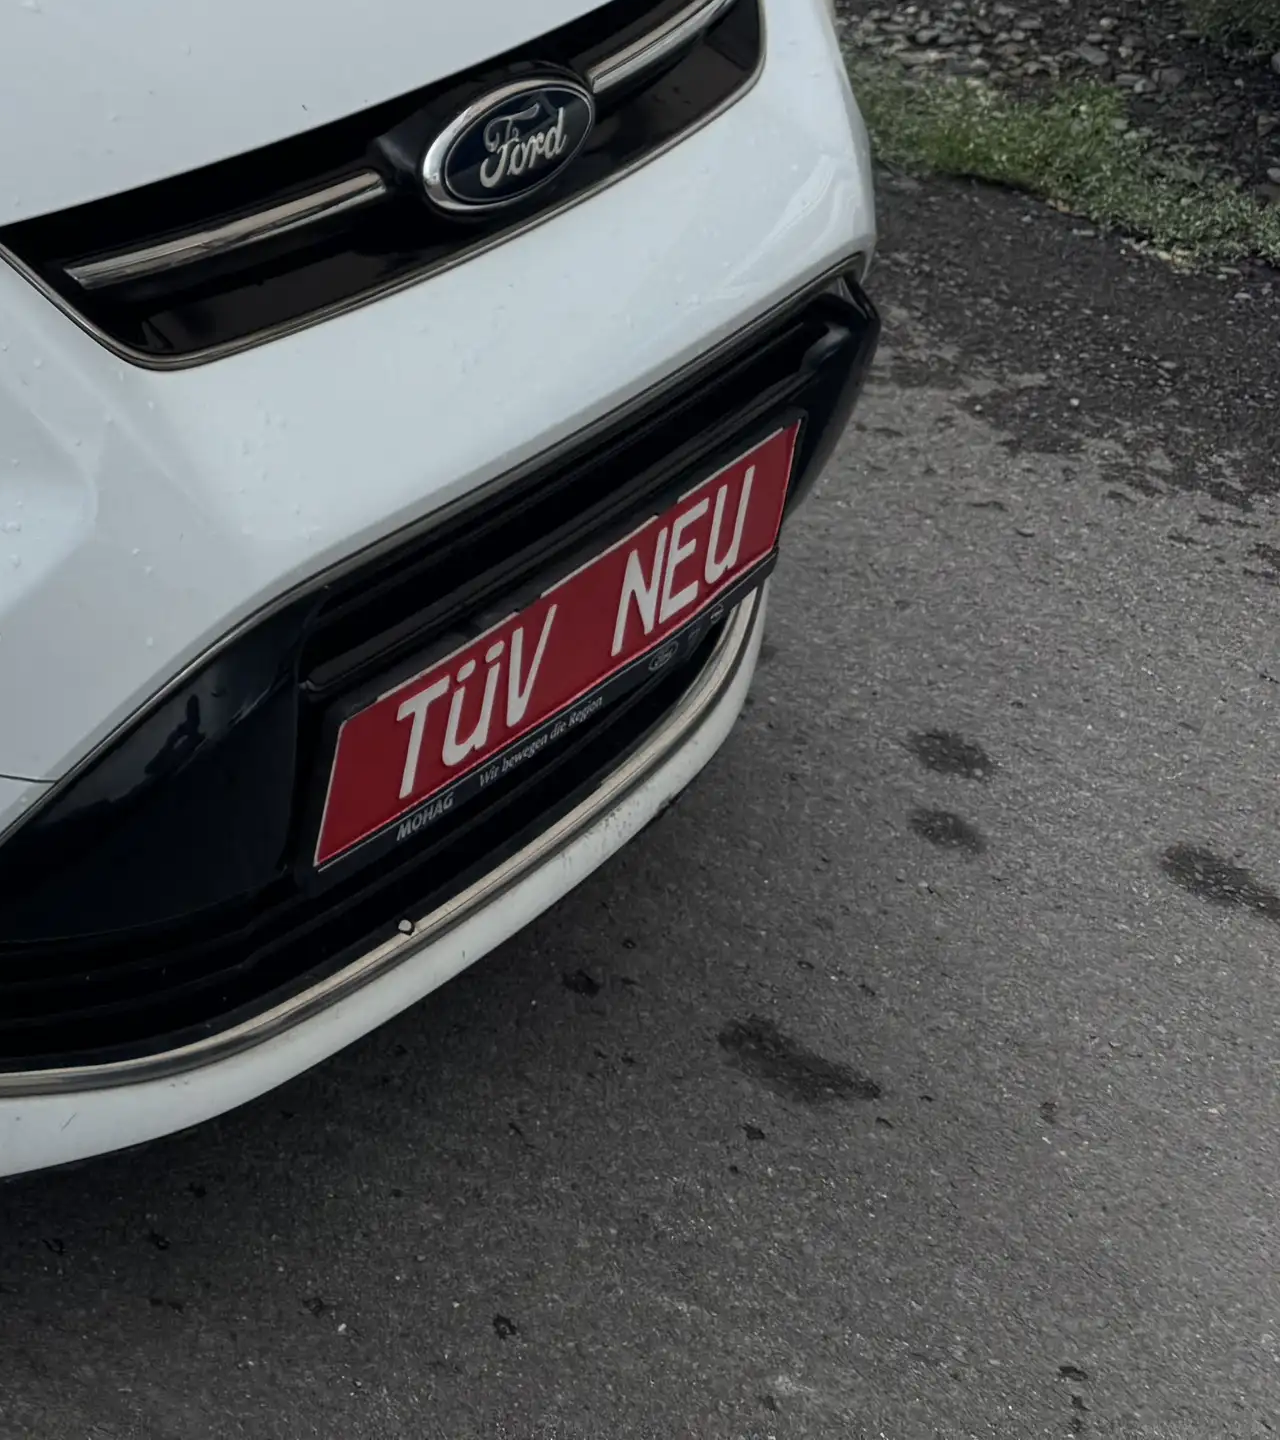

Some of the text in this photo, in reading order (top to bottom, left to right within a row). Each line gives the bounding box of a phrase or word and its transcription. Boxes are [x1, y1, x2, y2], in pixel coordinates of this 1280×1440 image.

[479, 102, 568, 189] Ford
[396, 464, 756, 799] TÜV NEU
[396, 696, 603, 841] MOHAG Wir bewegen die Region
